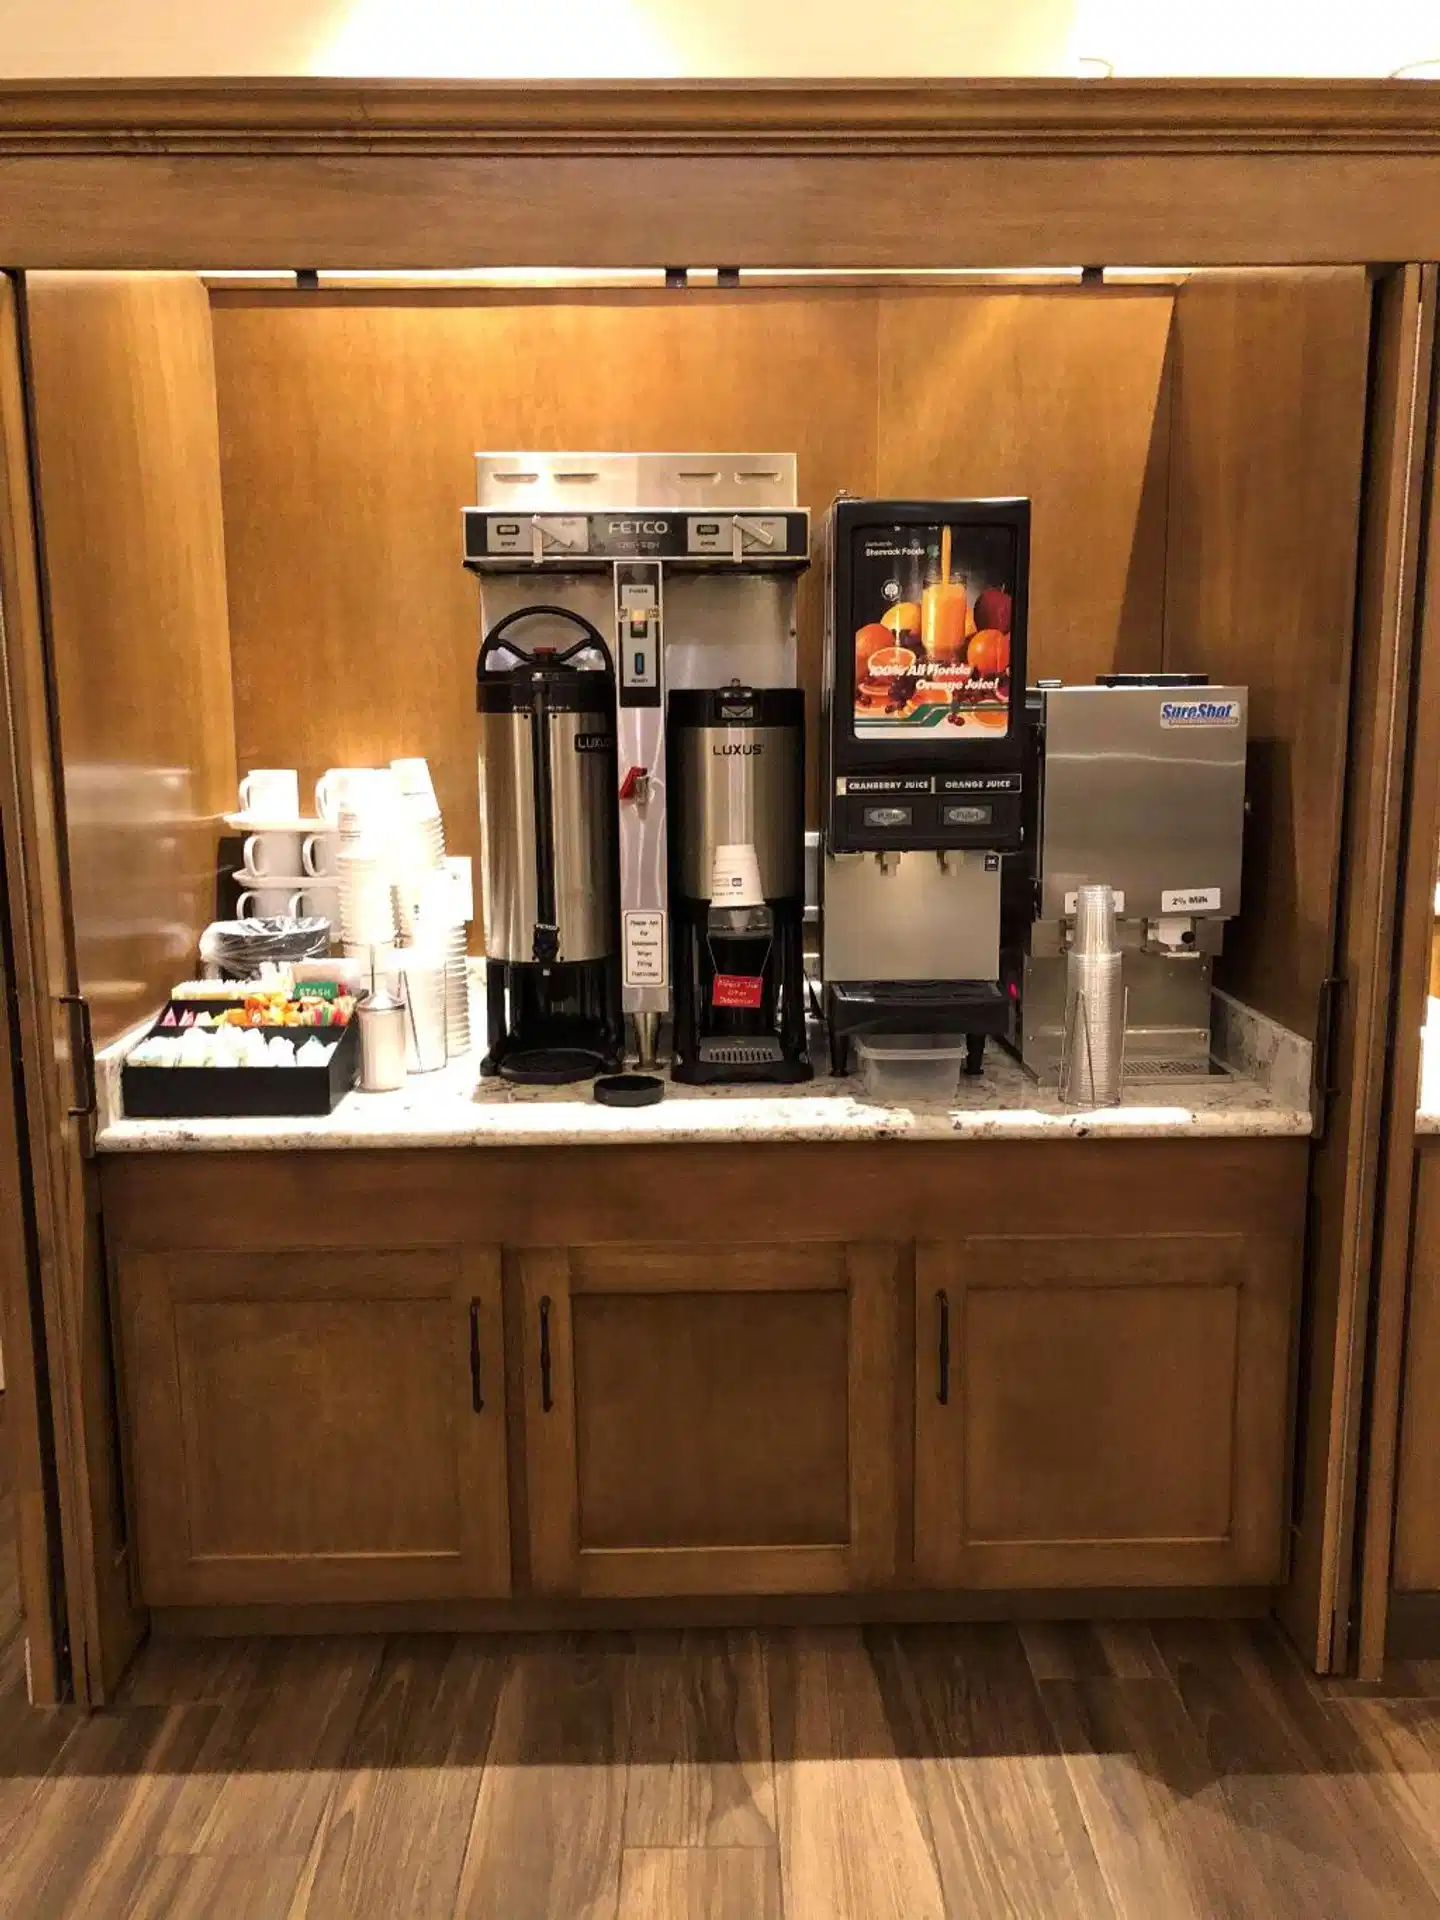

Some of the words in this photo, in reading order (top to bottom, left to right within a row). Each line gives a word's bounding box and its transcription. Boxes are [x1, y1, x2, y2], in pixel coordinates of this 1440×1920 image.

[609, 521, 668, 534] FETCO
[907, 664, 925, 676] All
[927, 663, 971, 677] Florida
[915, 679, 963, 692] Orange
[965, 678, 999, 690] Juice!
[1162, 703, 1232, 719] SureShot
[712, 743, 763, 756] LUXUS
[849, 780, 902, 790] CRANBERRY
[904, 780, 929, 789] JUICE
[945, 781, 983, 789] ORANGE
[986, 779, 1011, 788] JUICE
[1188, 895, 1208, 904] Milk
[299, 987, 331, 997] STASH
